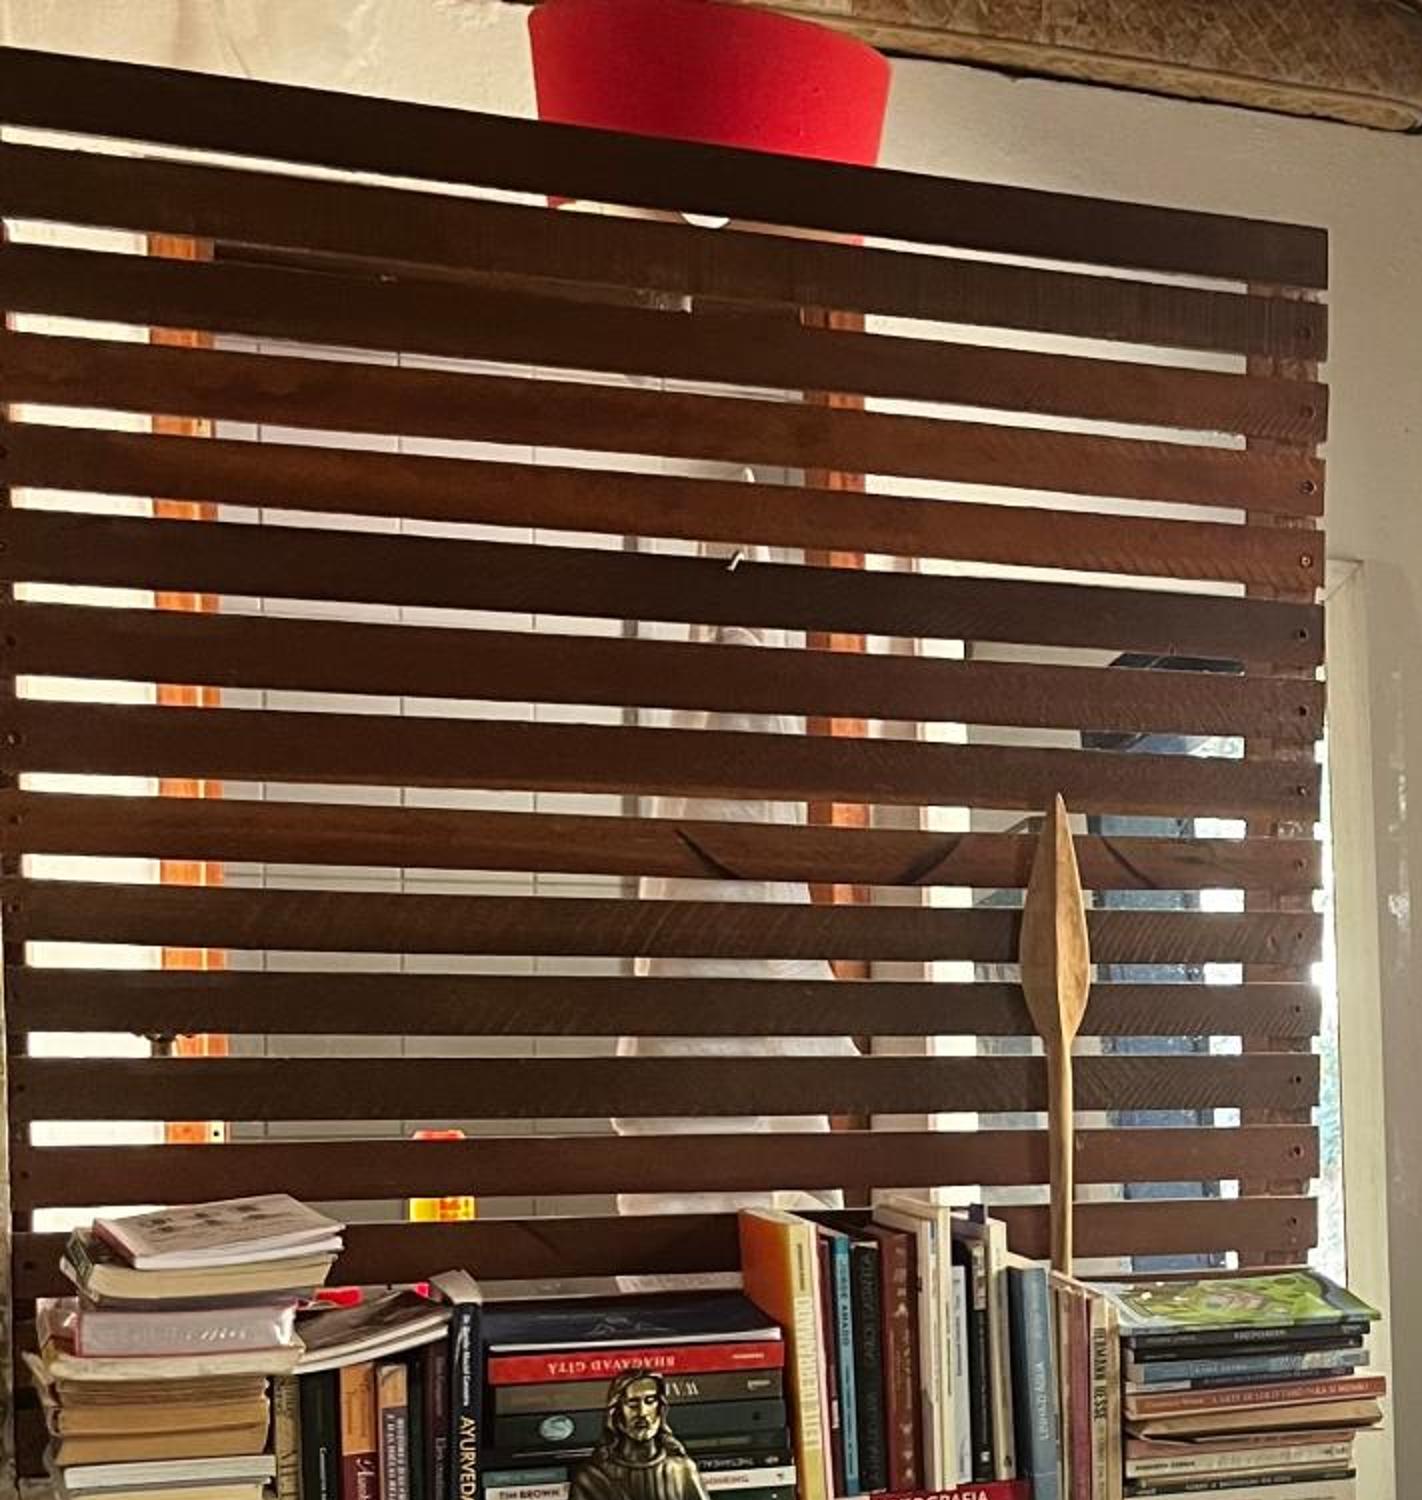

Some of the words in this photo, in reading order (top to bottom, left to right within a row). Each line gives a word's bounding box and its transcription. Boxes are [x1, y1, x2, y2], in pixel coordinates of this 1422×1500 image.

[1092, 1327, 1107, 1381] HERMANN
[1094, 1385, 1108, 1420] HESSE
[519, 1488, 559, 1500] BROWN
